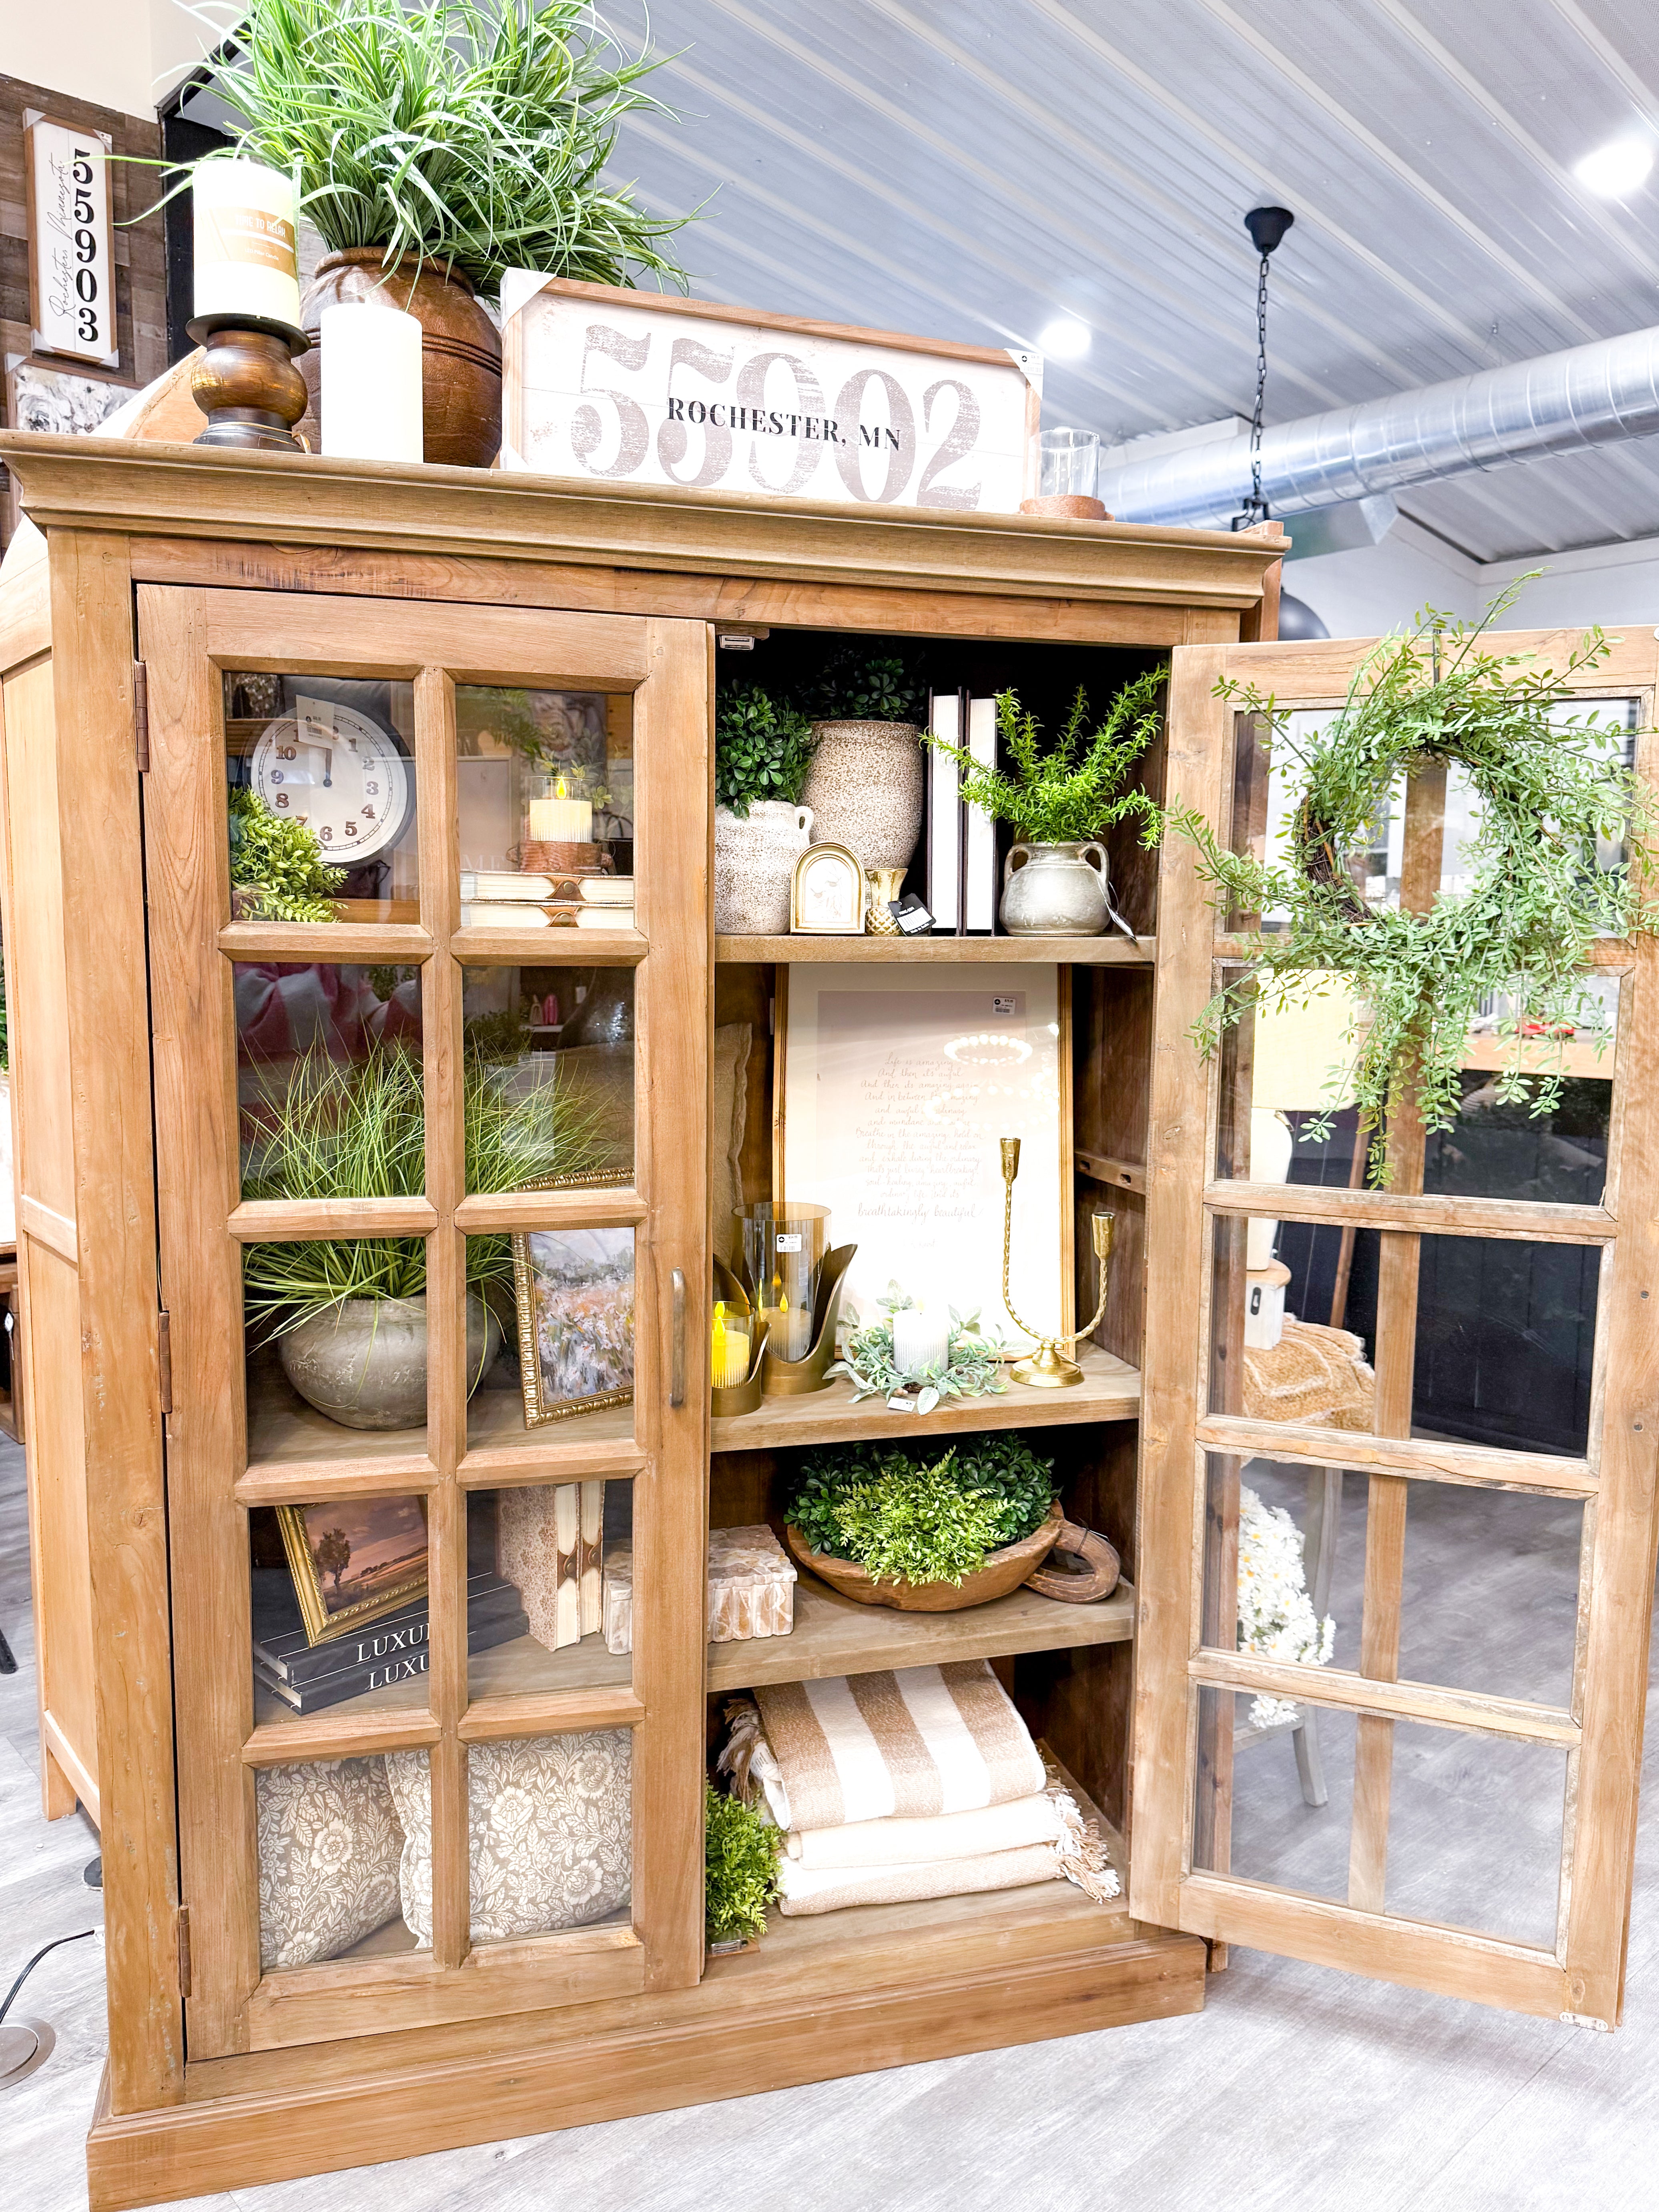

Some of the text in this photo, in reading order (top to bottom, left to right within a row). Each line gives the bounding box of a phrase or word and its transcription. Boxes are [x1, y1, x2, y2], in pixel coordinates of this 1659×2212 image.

[235, 215, 285, 238] TIME TO RELAX
[73, 148, 98, 342] 55903
[570, 324, 982, 510] 55902
[667, 397, 901, 451] ROCHESTER, MN
[348, 738, 358, 753] 1
[276, 746, 297, 761] 10
[362, 756, 375, 771] 2
[271, 769, 284, 784] 9
[366, 781, 379, 796] 3
[275, 793, 289, 808] 8
[361, 804, 375, 818] 4
[320, 826, 333, 842] 6
[345, 821, 357, 837] 5
[885, 1052, 901, 1067] Life
[916, 1060, 954, 1071] amazing
[878, 1068, 896, 1078] And
[900, 1069, 917, 1079] then
[939, 1067, 964, 1080] awful
[861, 1080, 877, 1088] And
[883, 1080, 899, 1088] then
[919, 1081, 953, 1092] amazing
[865, 1092, 884, 1101] And
[898, 1092, 926, 1101] between
[947, 1095, 979, 1106] mazing
[875, 1105, 891, 1114] and
[896, 1104, 919, 1117] awful
[934, 1104, 967, 1117] rdinary
[868, 1116, 885, 1125] and
[889, 1116, 924, 1125] mundane
[856, 1127, 886, 1139] Breathe
[899, 1129, 911, 1137] the
[954, 1129, 971, 1138] hold
[865, 1139, 897, 1155] through
[903, 1141, 915, 1150] the
[944, 1141, 958, 1150] and
[959, 1141, 977, 1150] relax
[859, 1151, 876, 1162] and
[882, 1151, 907, 1162] exhale
[909, 1151, 932, 1169] during
[935, 1151, 949, 1162] the
[886, 1163, 901, 1178] just
[904, 1163, 925, 1180] living
[880, 1188, 910, 1204] ordinary
[858, 1202, 930, 1225] breathtakingly
[357, 1622, 429, 1663] LUXU
